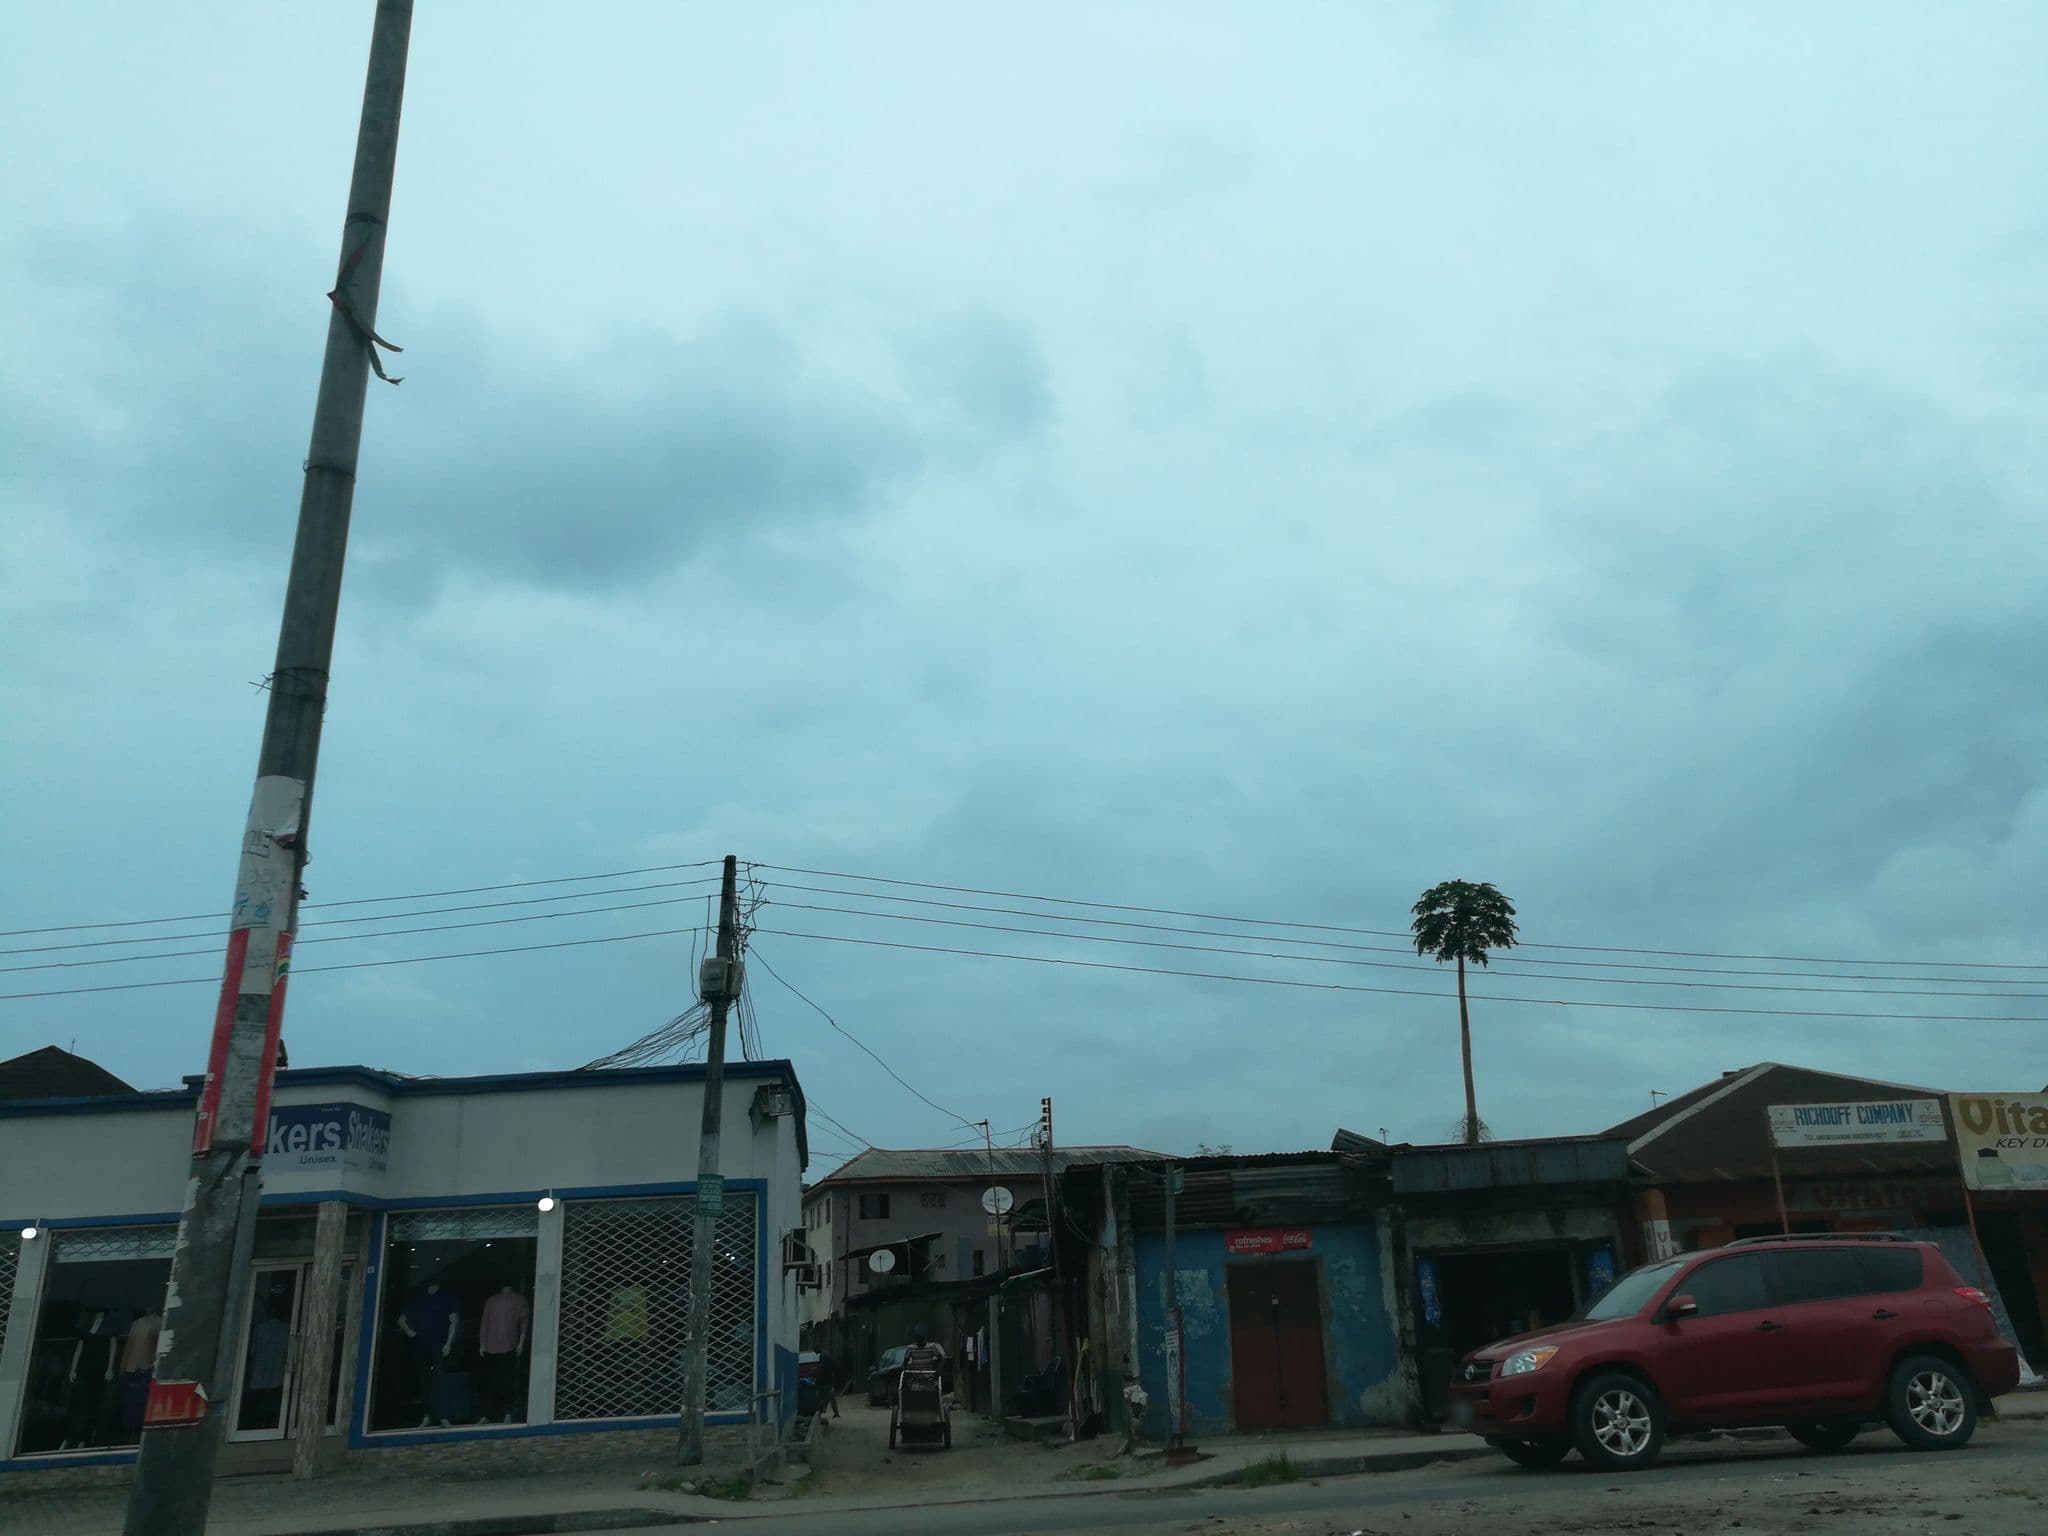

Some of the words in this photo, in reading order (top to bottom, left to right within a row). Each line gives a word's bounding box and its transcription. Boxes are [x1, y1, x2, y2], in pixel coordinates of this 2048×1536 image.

[1856, 1103, 1913, 1124] COMPANY
[266, 1115, 342, 1154] kers
[347, 1110, 390, 1155] Shakers
[1995, 1137, 2029, 1149] KEY
[2032, 1137, 2048, 1149] D
[299, 1154, 337, 1165] Unisex
